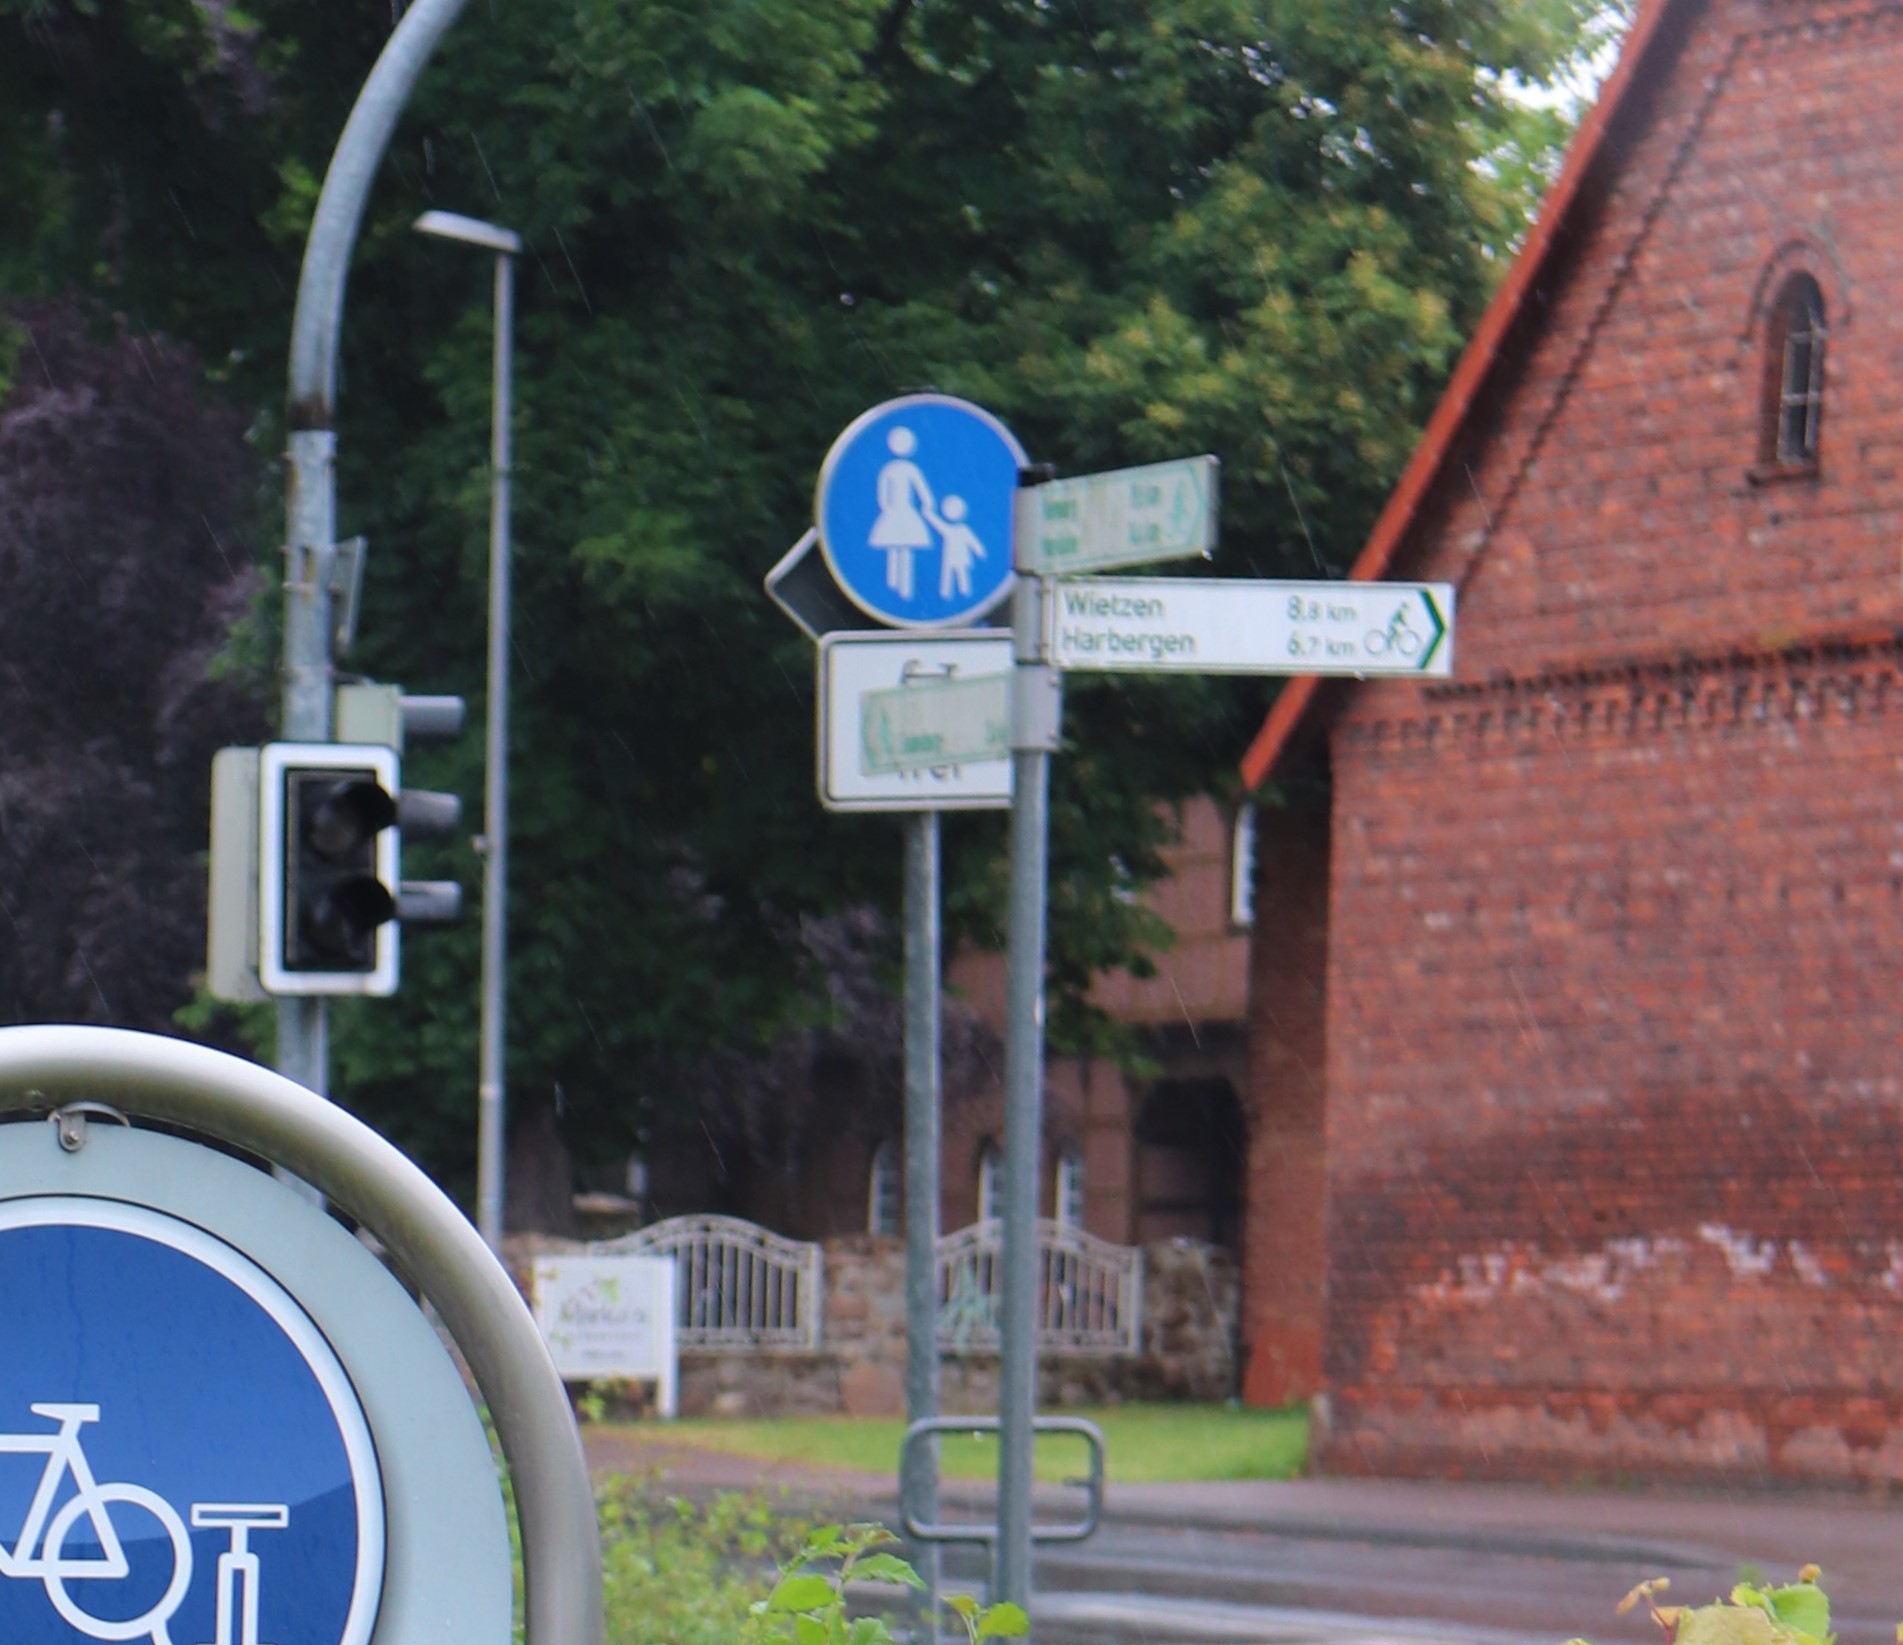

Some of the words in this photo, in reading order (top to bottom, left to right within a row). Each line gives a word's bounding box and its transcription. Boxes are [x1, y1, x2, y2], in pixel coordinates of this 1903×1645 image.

[1063, 590, 1165, 618] Wietzen
[1326, 602, 1357, 621] km
[1062, 626, 1195, 659] Harbergen
[1325, 637, 1356, 657] km
